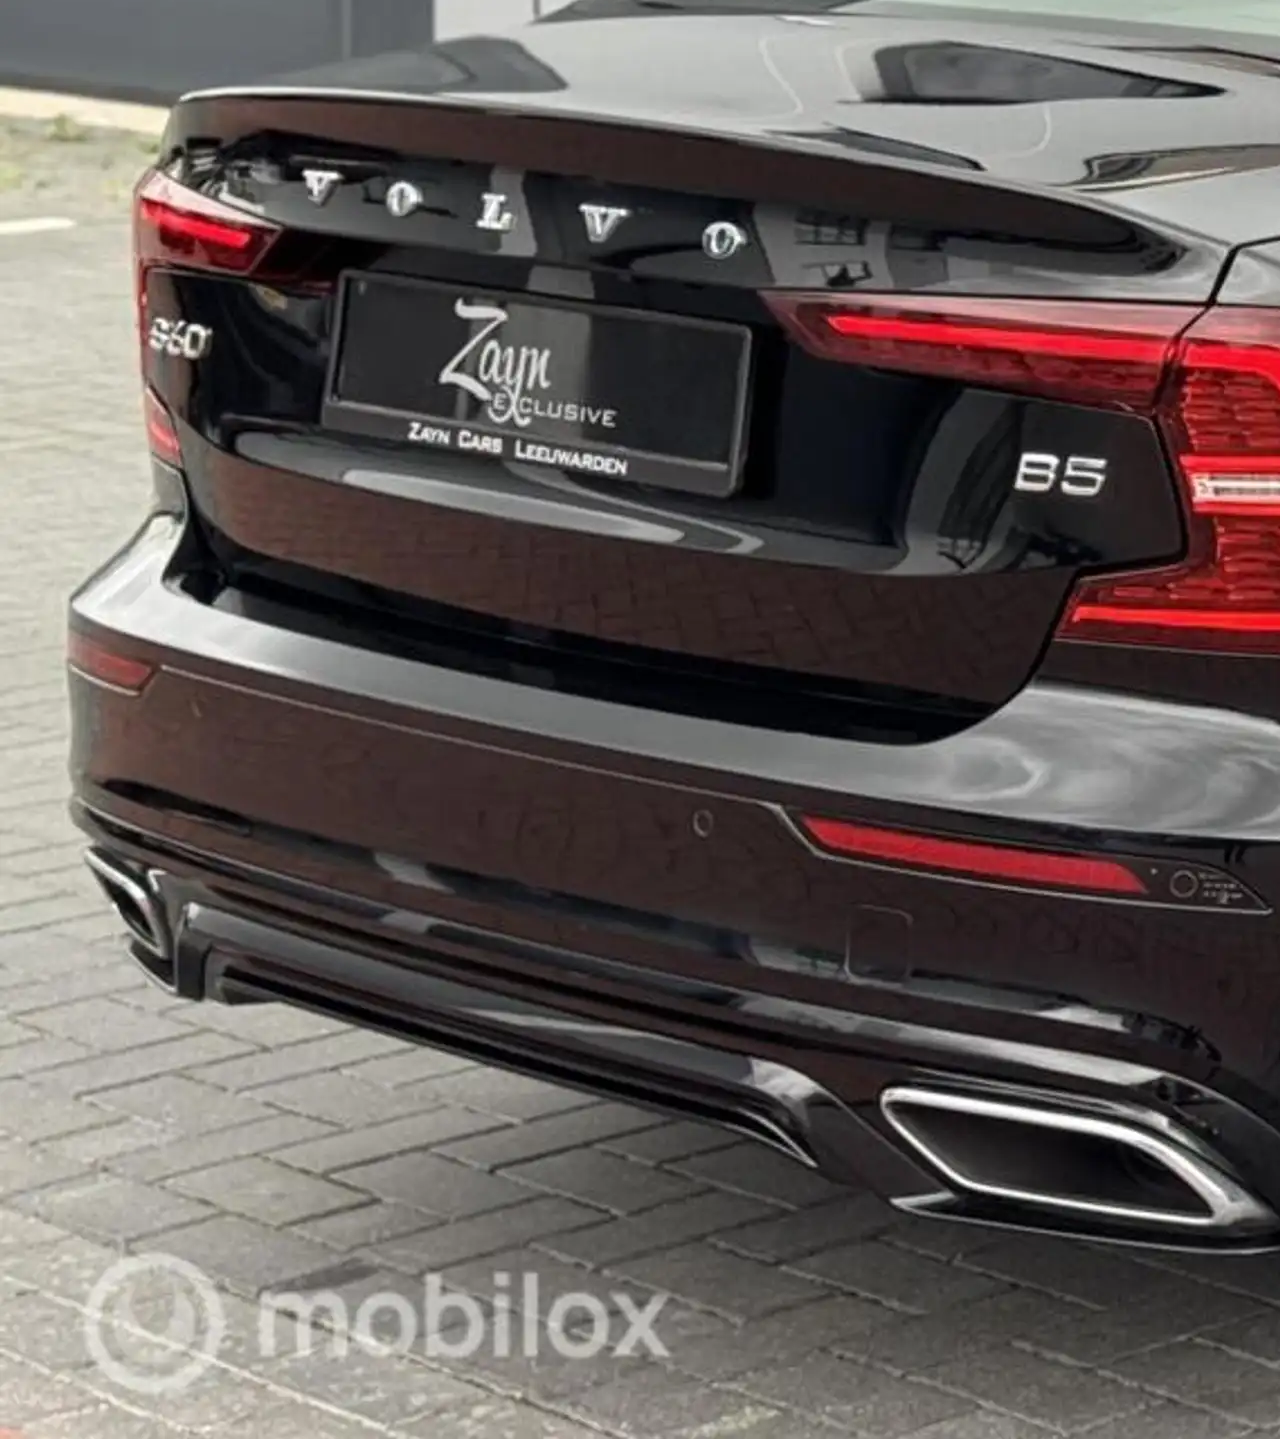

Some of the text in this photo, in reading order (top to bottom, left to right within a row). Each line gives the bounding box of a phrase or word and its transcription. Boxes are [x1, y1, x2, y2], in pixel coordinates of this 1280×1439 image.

[303, 169, 748, 259] VOLVO
[149, 317, 213, 358] S60
[438, 297, 552, 427] Zayn
[1013, 452, 1108, 496] B5
